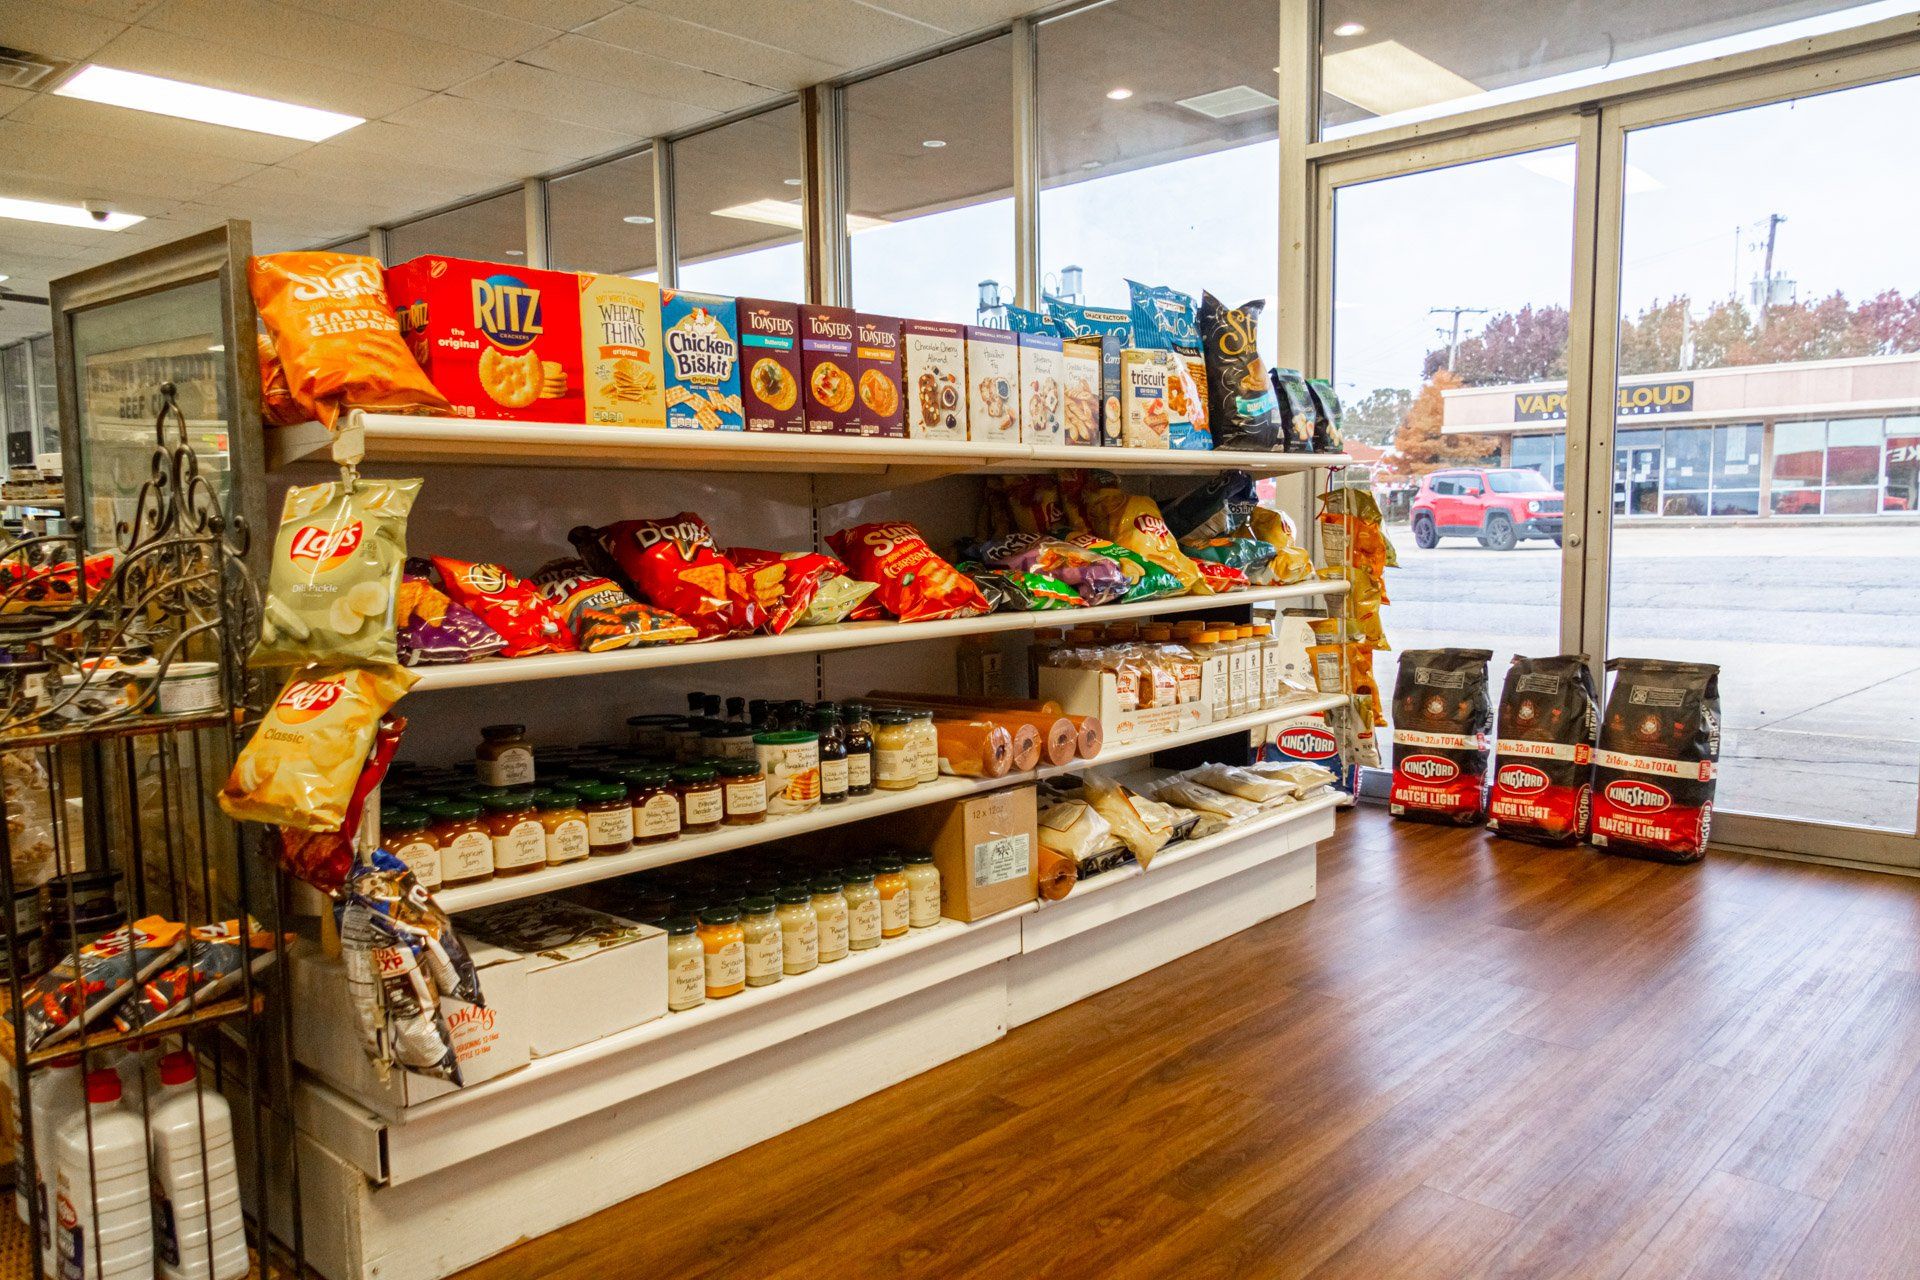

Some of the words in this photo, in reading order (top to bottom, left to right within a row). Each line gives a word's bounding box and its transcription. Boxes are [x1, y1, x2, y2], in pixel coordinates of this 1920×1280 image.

[470, 278, 544, 334] RITZ
[598, 303, 645, 325] WHEAT
[451, 328, 465, 337] the
[748, 311, 794, 335] TOASTEDS
[809, 317, 853, 340] TOASTEDS
[438, 337, 480, 351] original
[669, 332, 733, 357] Chicken
[858, 326, 897, 348] TOASTEDS
[676, 353, 728, 376] Biskit
[1131, 370, 1166, 387] triscuit
[1618, 385, 1692, 408] LOUD
[292, 523, 361, 562] Lay's
[278, 678, 341, 711] Lay's
[263, 728, 305, 744] Classic
[1280, 733, 1335, 754] KINGSFORD
[1440, 736, 1465, 747] TOTAL
[1531, 745, 1555, 756] TOTAL
[1404, 760, 1454, 778] KINGSFORD
[1651, 761, 1678, 774] TOTAL
[1430, 790, 1461, 806] LIGHT
[1609, 786, 1665, 807] KINGSFORD
[1519, 804, 1550, 820] LIGHT
[1599, 816, 1633, 835] MATCH
[1635, 821, 1672, 841] LIGHT
